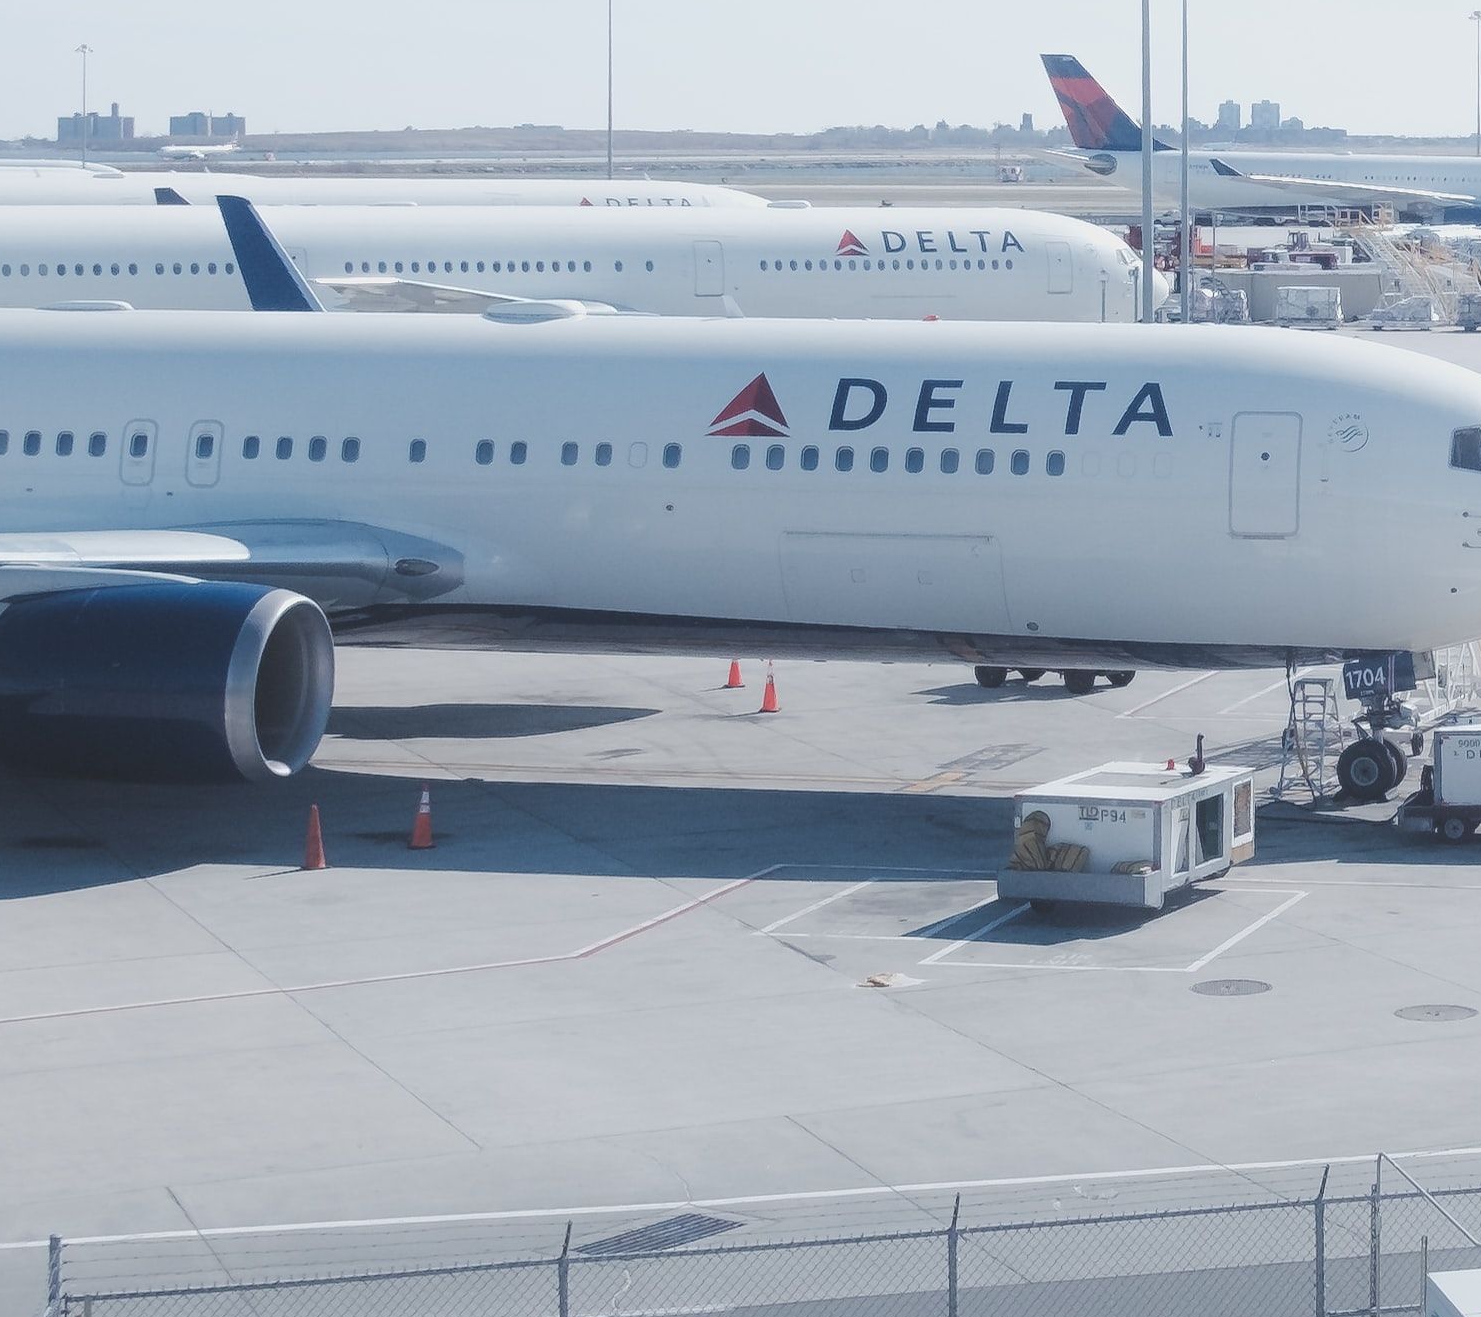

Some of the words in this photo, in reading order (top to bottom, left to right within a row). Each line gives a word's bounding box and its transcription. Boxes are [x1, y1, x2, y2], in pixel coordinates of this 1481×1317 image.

[881, 230, 1025, 254] DELTA
[828, 377, 1174, 438] DELTA
[1345, 666, 1387, 689] 1704
[1079, 806, 1099, 820] TLD
[1101, 809, 1126, 824] P94
